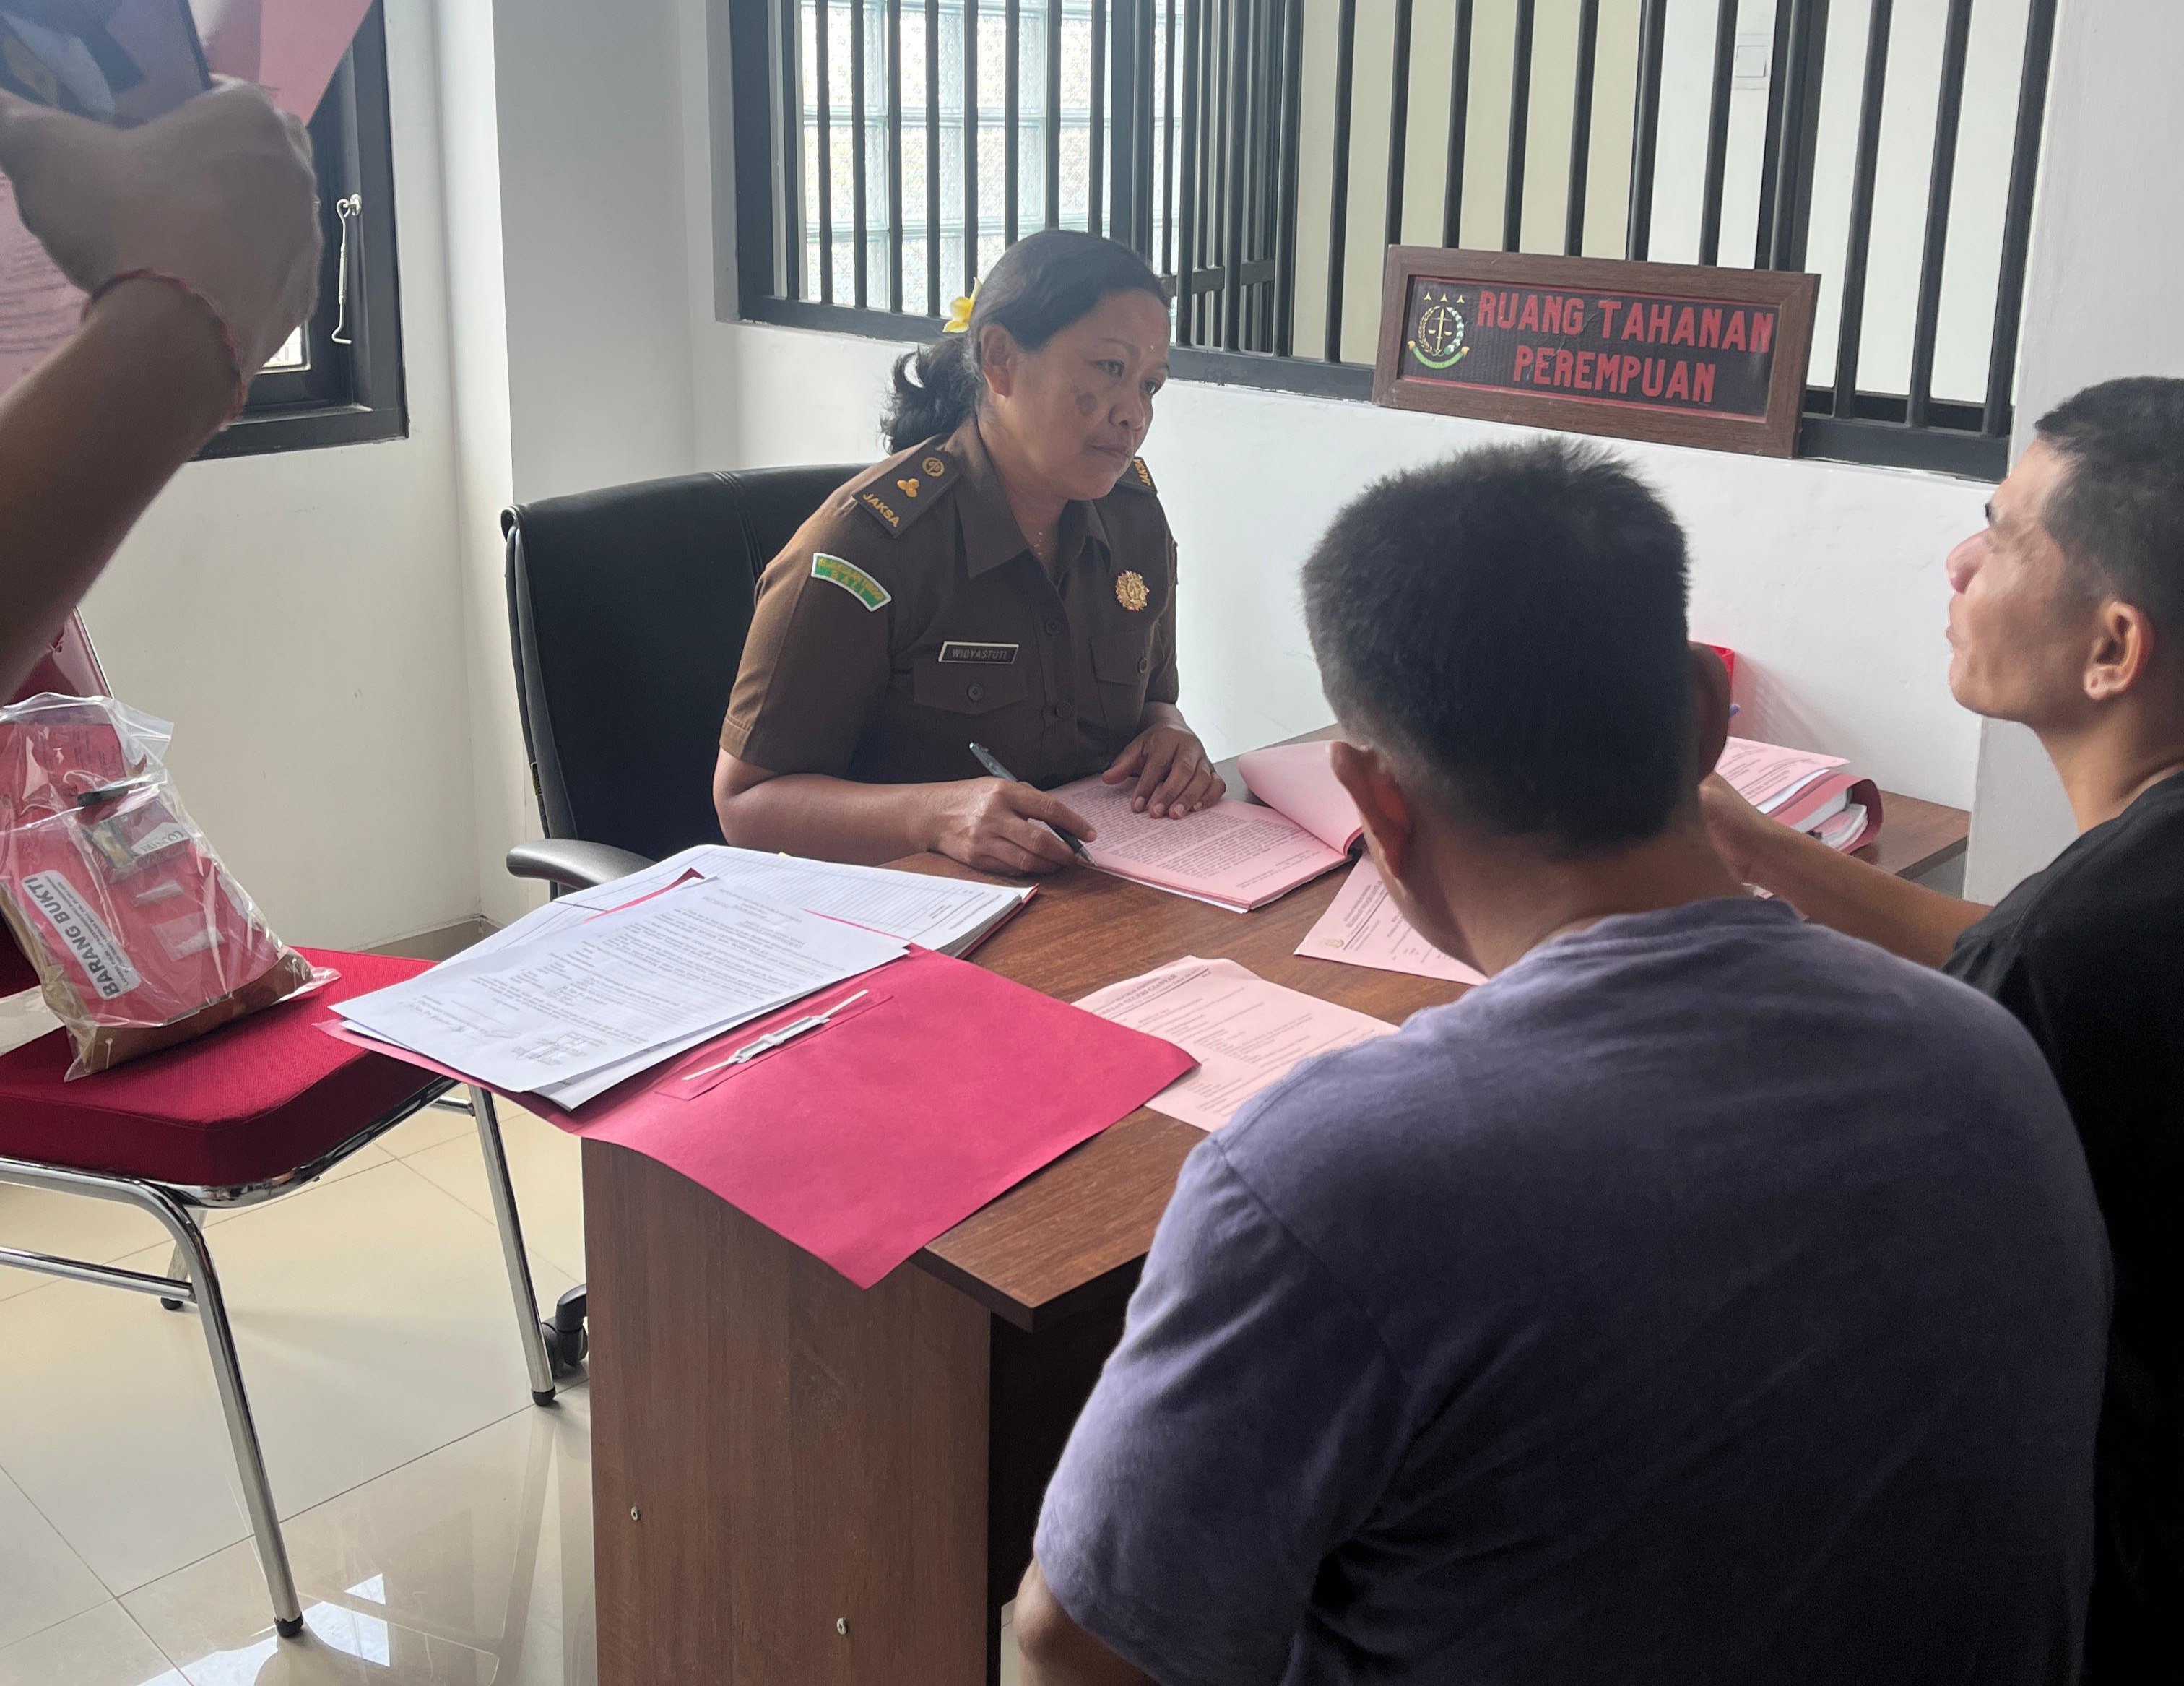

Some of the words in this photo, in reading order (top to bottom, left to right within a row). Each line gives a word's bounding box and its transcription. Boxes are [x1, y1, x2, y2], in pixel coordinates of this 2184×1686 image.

[1477, 290, 1585, 337] RUANG
[1598, 300, 1774, 354] TAHANAN
[1513, 345, 1717, 404] PEREMPUAN
[862, 493, 900, 527] JAKSA
[951, 649, 1008, 660] WIDYASTUTI
[25, 877, 71, 924] BUKTI
[64, 925, 120, 997] BARANG
